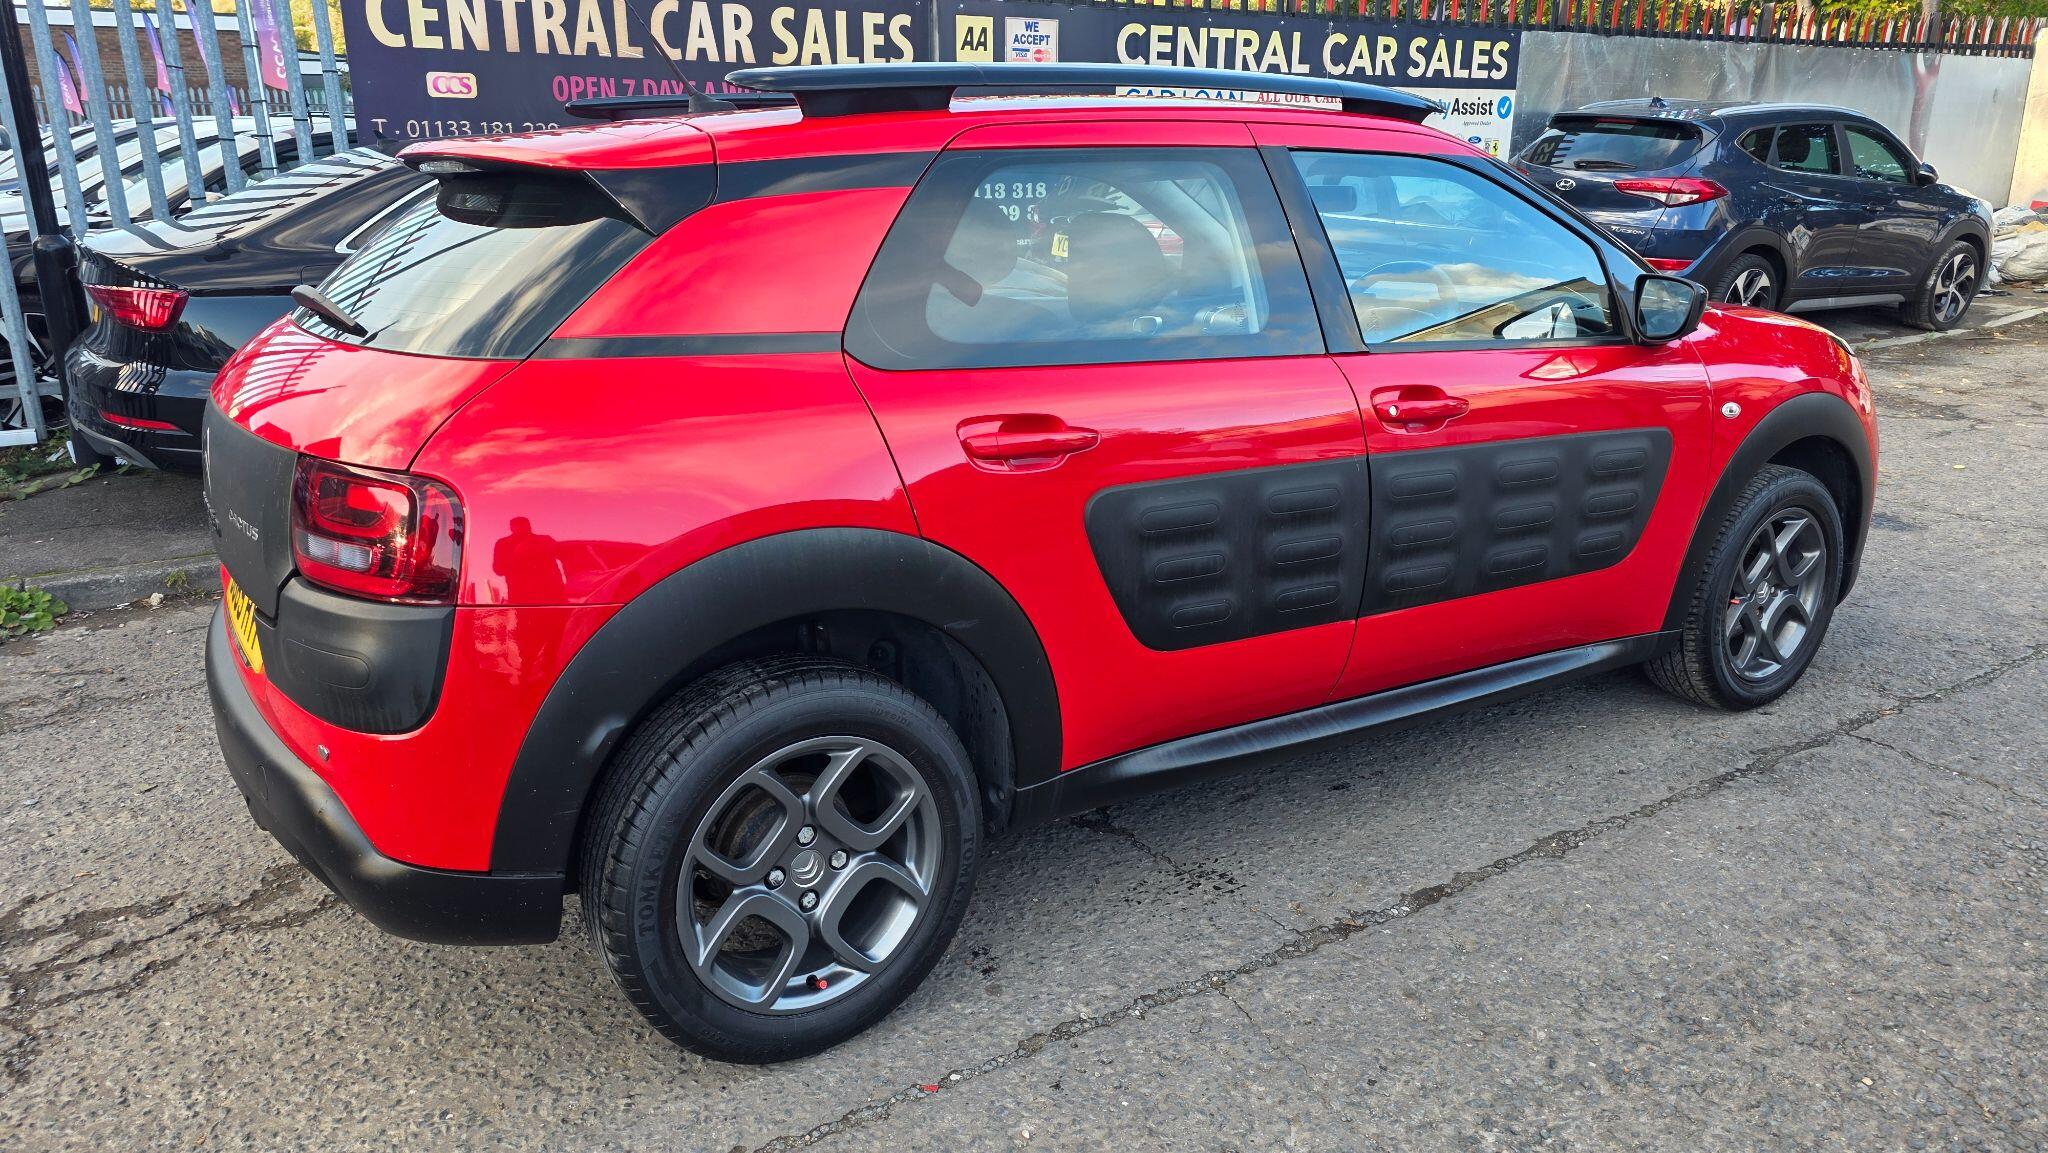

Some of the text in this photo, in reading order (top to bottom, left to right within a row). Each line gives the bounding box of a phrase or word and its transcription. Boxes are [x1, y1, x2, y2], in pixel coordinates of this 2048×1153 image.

[365, 0, 914, 66] CENTRAL CAR SALES
[1024, 21, 1040, 33] WE
[961, 26, 988, 52] AA
[1012, 33, 1050, 46] ACCEPT
[1116, 23, 1510, 81] CENTRAL CAR SALES
[432, 75, 472, 96] CCS
[552, 75, 615, 102] OPEN
[1012, 182, 1047, 199] 318
[1610, 225, 1645, 235] TUCSON
[228, 508, 260, 541] CACTUS
